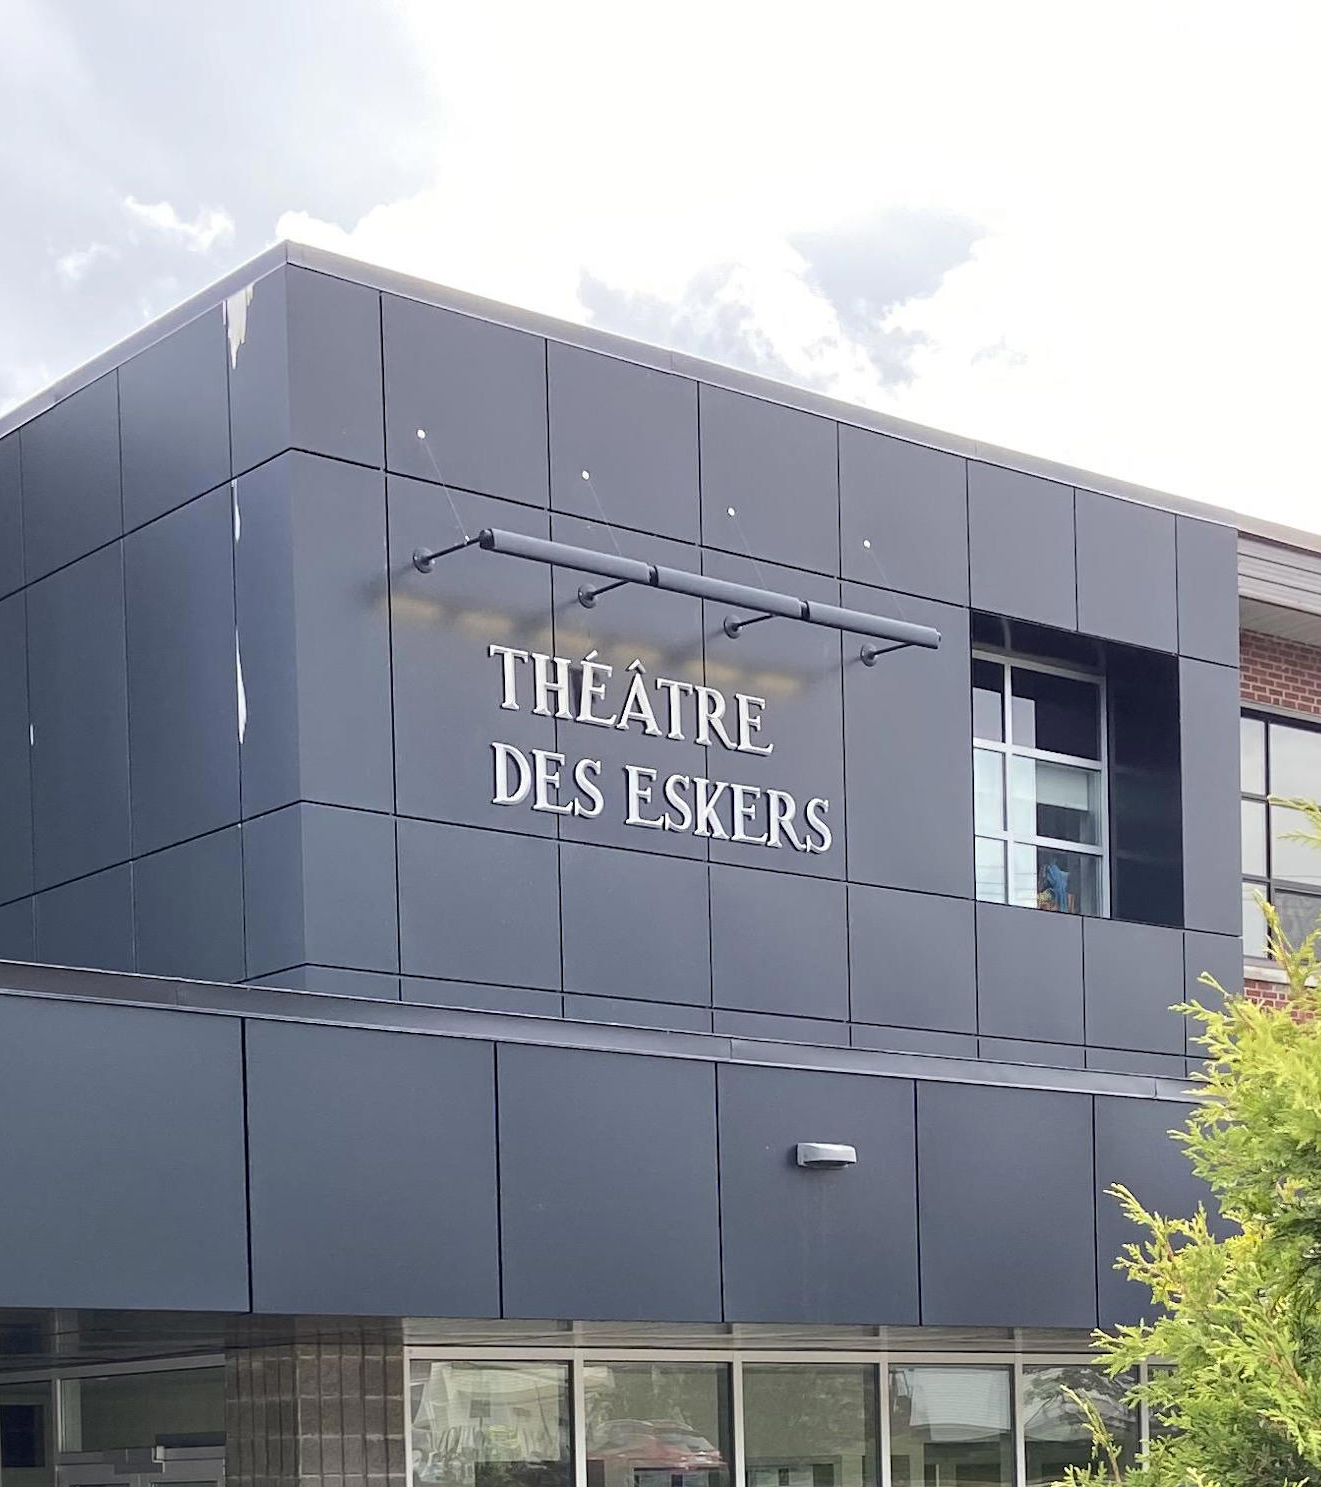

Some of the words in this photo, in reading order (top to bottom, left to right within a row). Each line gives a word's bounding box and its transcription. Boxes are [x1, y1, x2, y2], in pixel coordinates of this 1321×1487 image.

[489, 644, 774, 756] THÉÂTRE
[491, 741, 605, 818] DES
[624, 764, 833, 853] ESKERS
